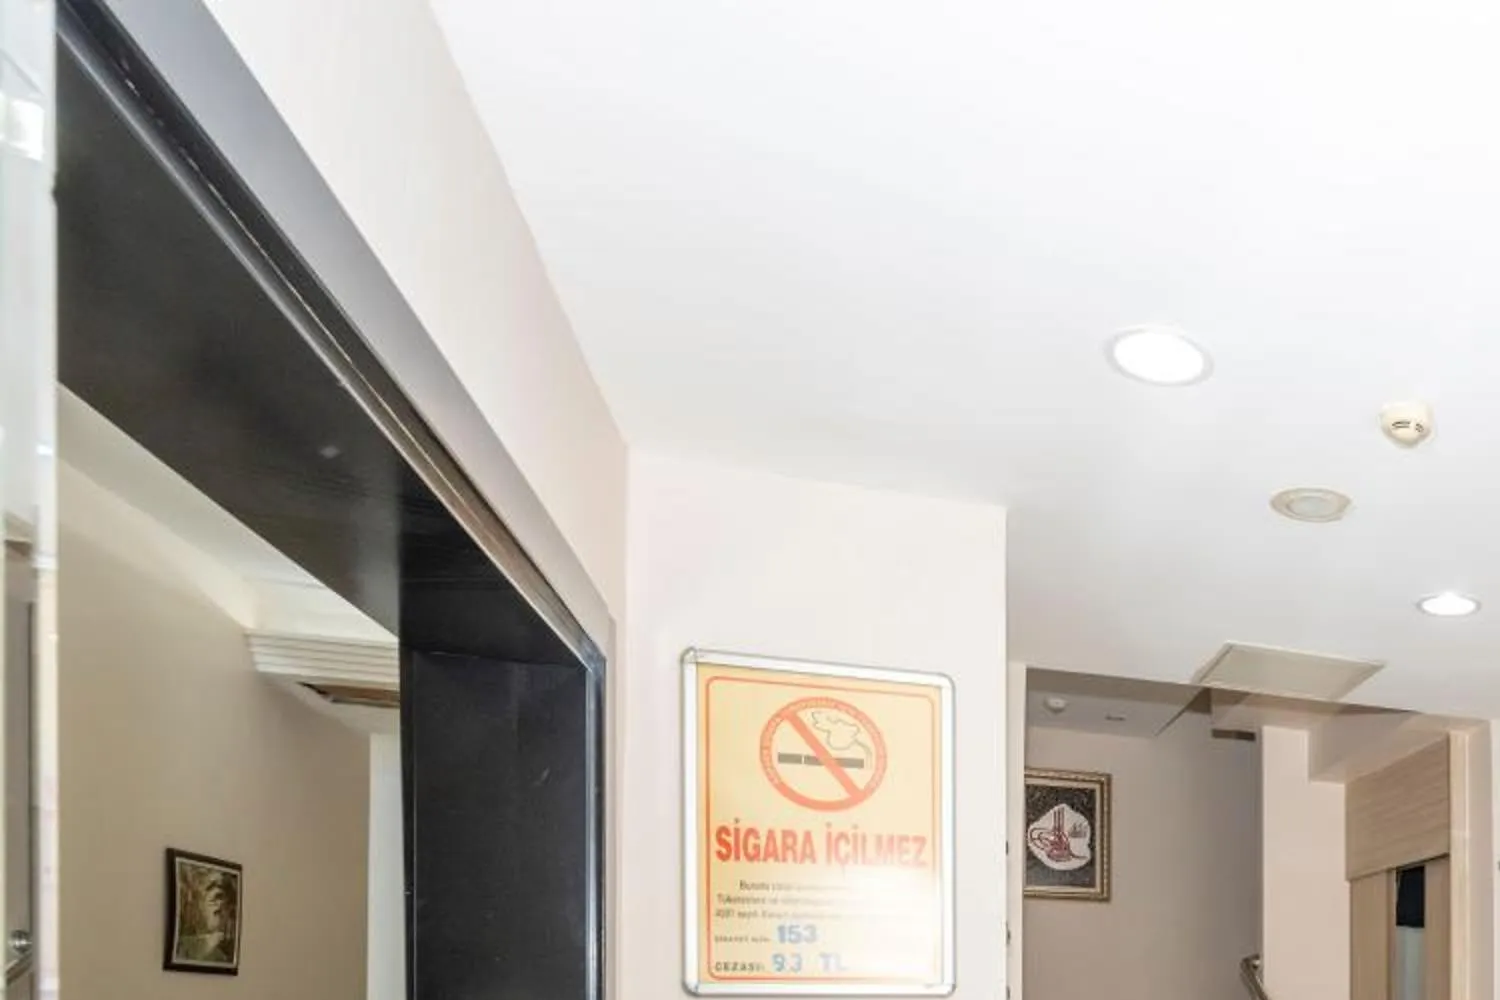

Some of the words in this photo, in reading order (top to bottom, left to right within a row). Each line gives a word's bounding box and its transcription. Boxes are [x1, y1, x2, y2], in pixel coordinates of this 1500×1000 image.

[715, 817, 816, 865] SİGARA
[825, 821, 928, 873] İÇİLMEZ
[777, 924, 818, 944] 153
[818, 951, 850, 972] TL
